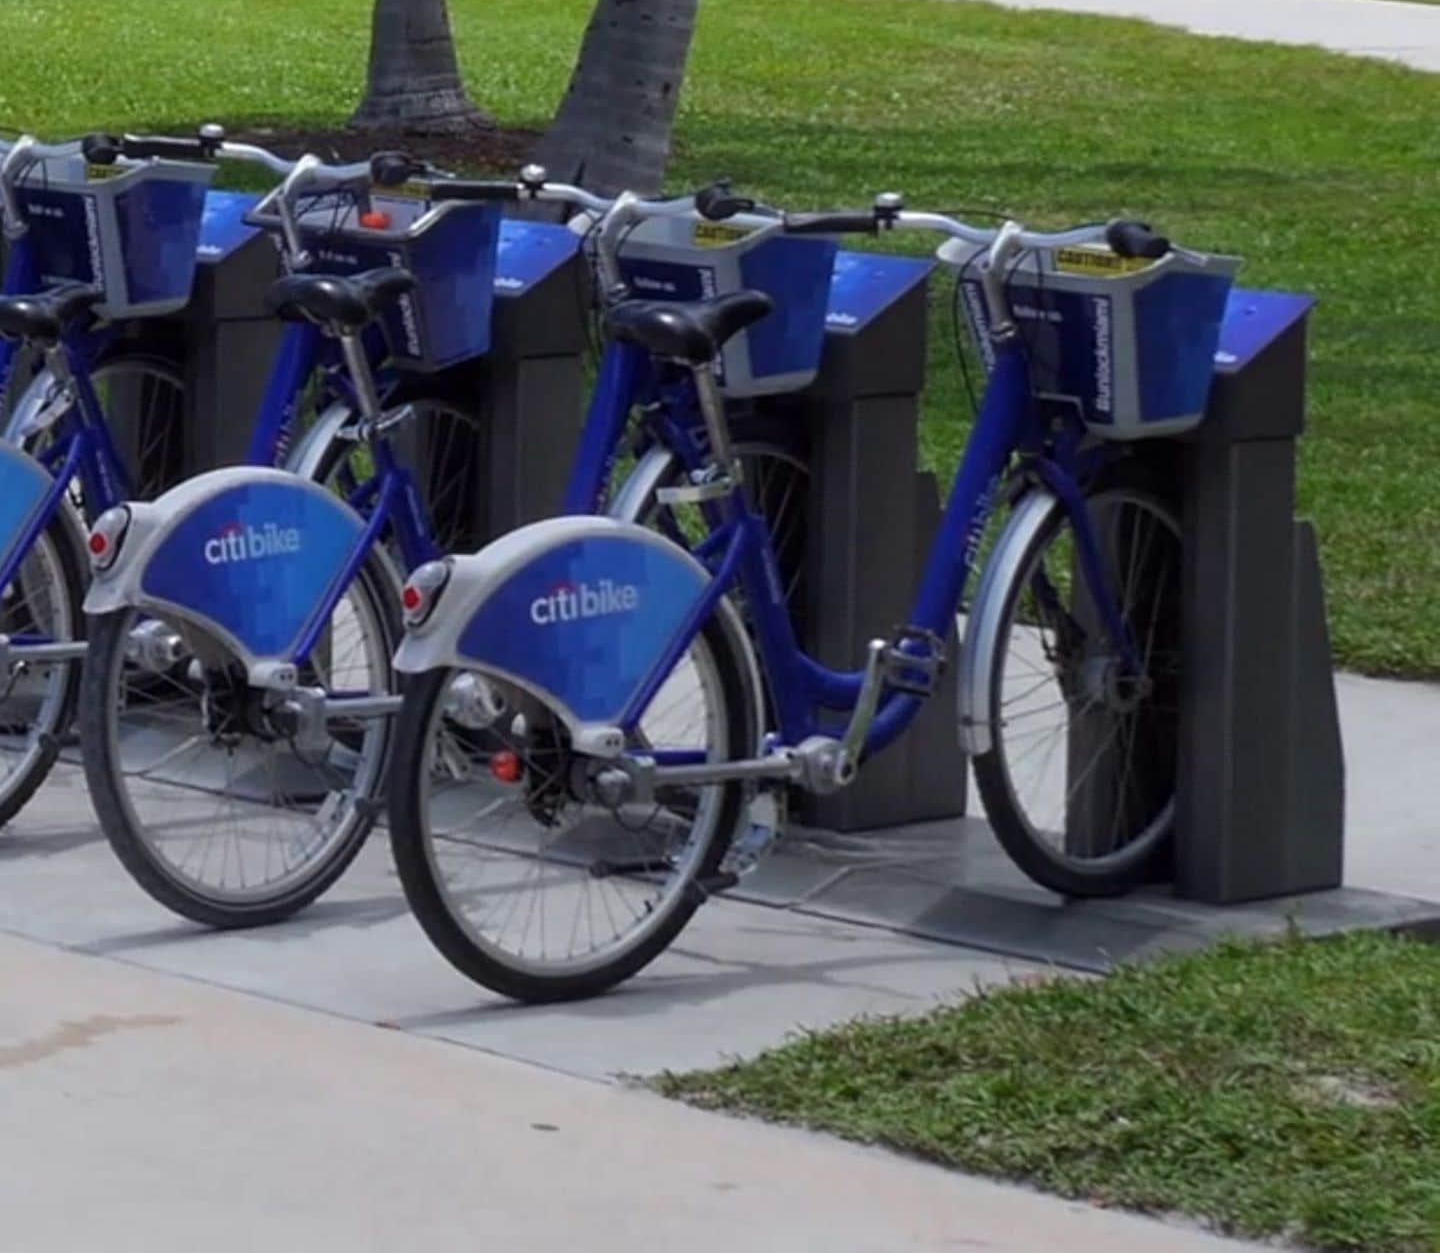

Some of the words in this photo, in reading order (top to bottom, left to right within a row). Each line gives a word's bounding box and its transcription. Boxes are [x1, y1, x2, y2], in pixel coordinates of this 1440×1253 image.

[204, 530, 247, 564] citi
[248, 523, 300, 557] bike
[530, 588, 578, 625] citi
[580, 579, 638, 617] bike
